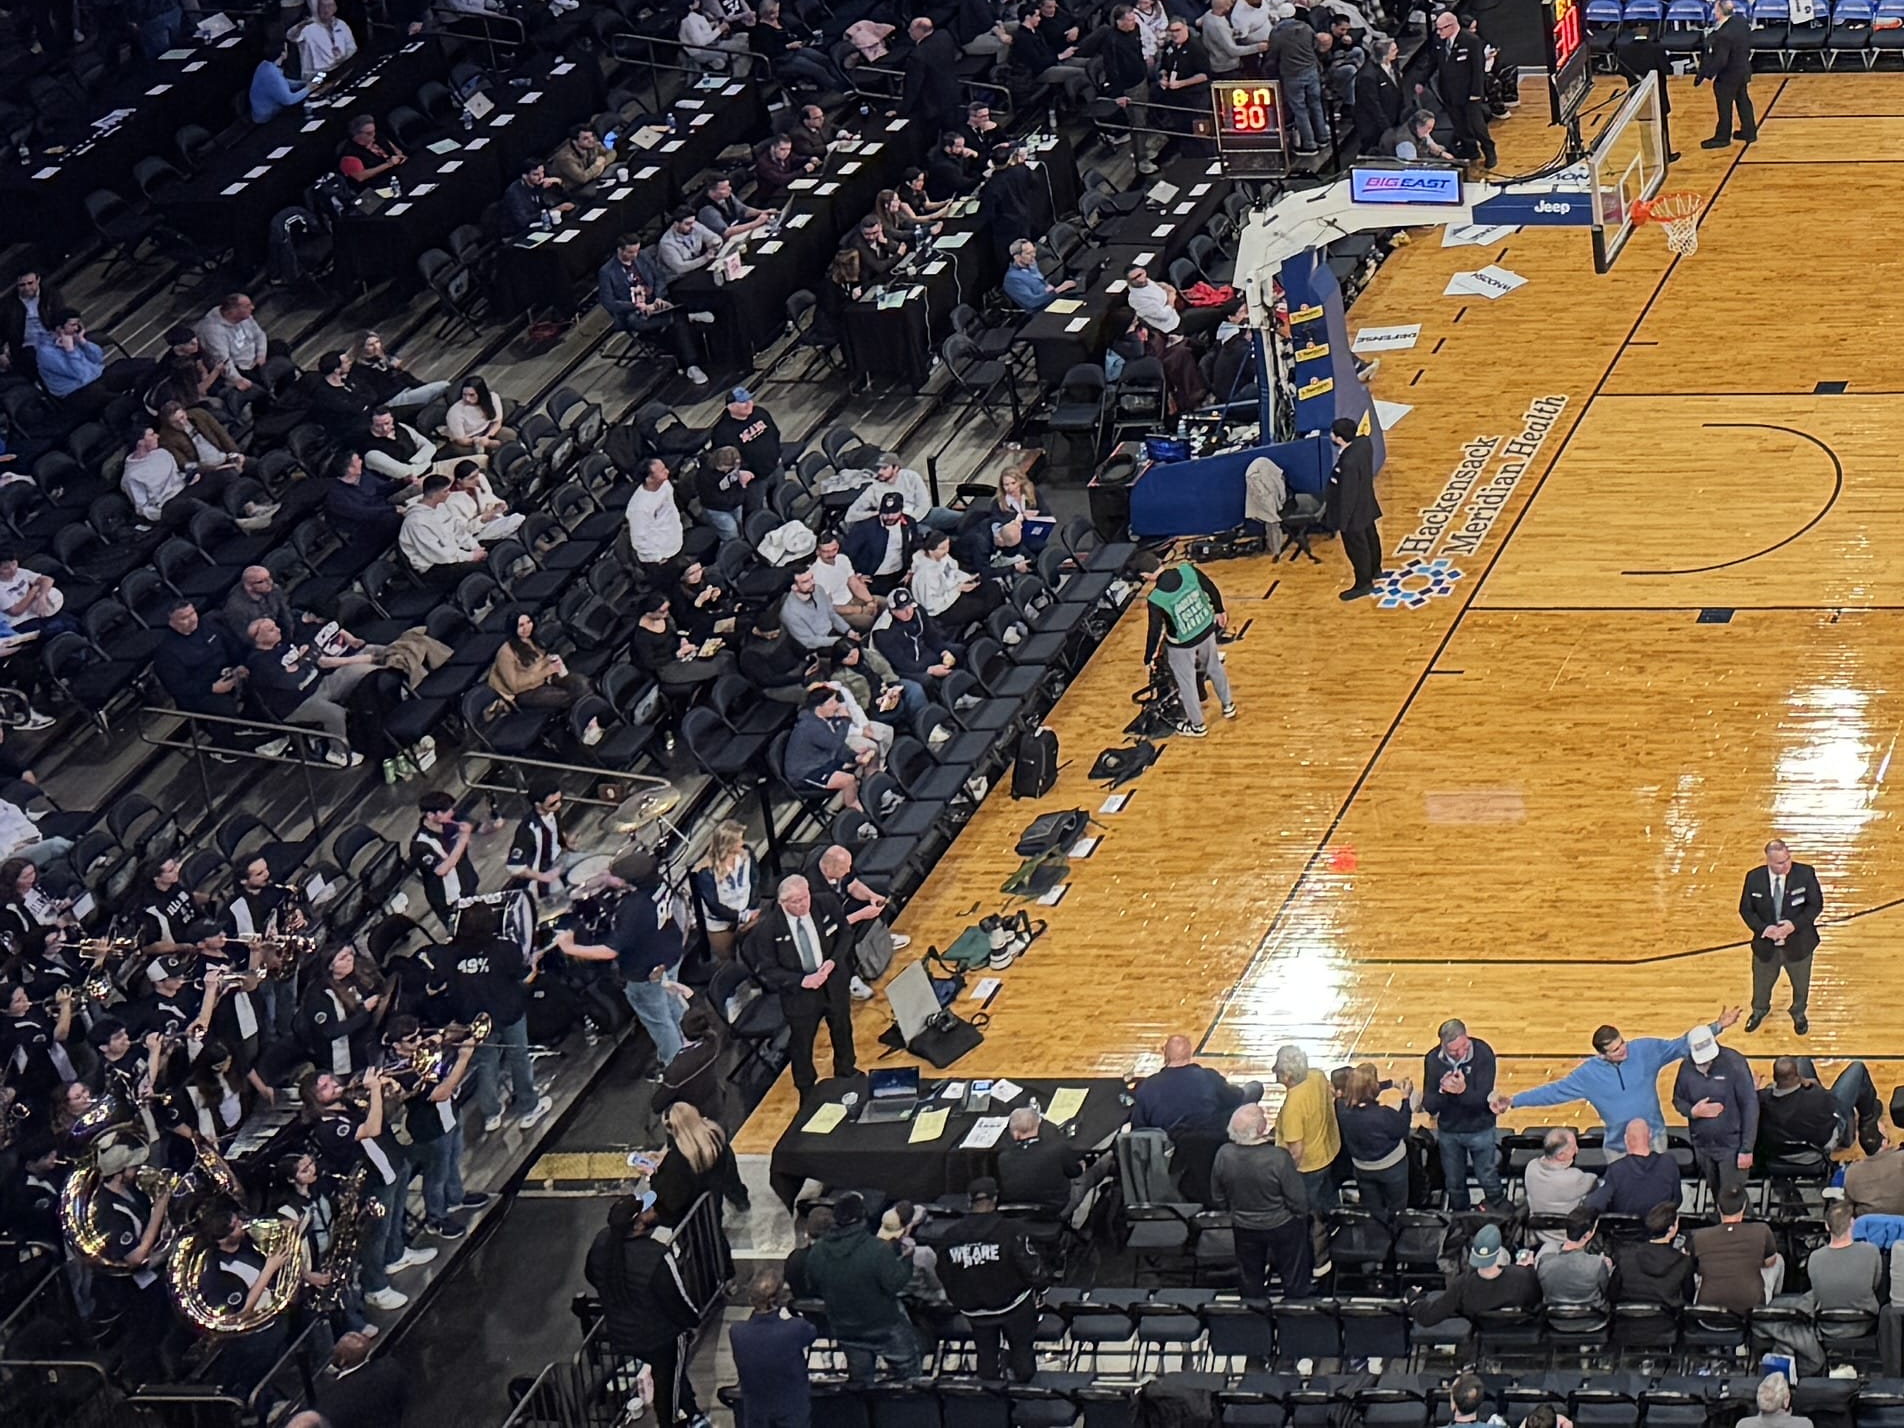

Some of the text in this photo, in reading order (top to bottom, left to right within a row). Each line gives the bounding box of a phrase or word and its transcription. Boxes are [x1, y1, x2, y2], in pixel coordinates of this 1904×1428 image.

[1233, 107, 1266, 130] 30
[1365, 176, 1453, 189] BIG EAST
[1533, 199, 1571, 215] Jeep
[1441, 393, 1568, 556] Meridian Health
[1396, 434, 1500, 556] Hackensack
[456, 957, 490, 975] 49%
